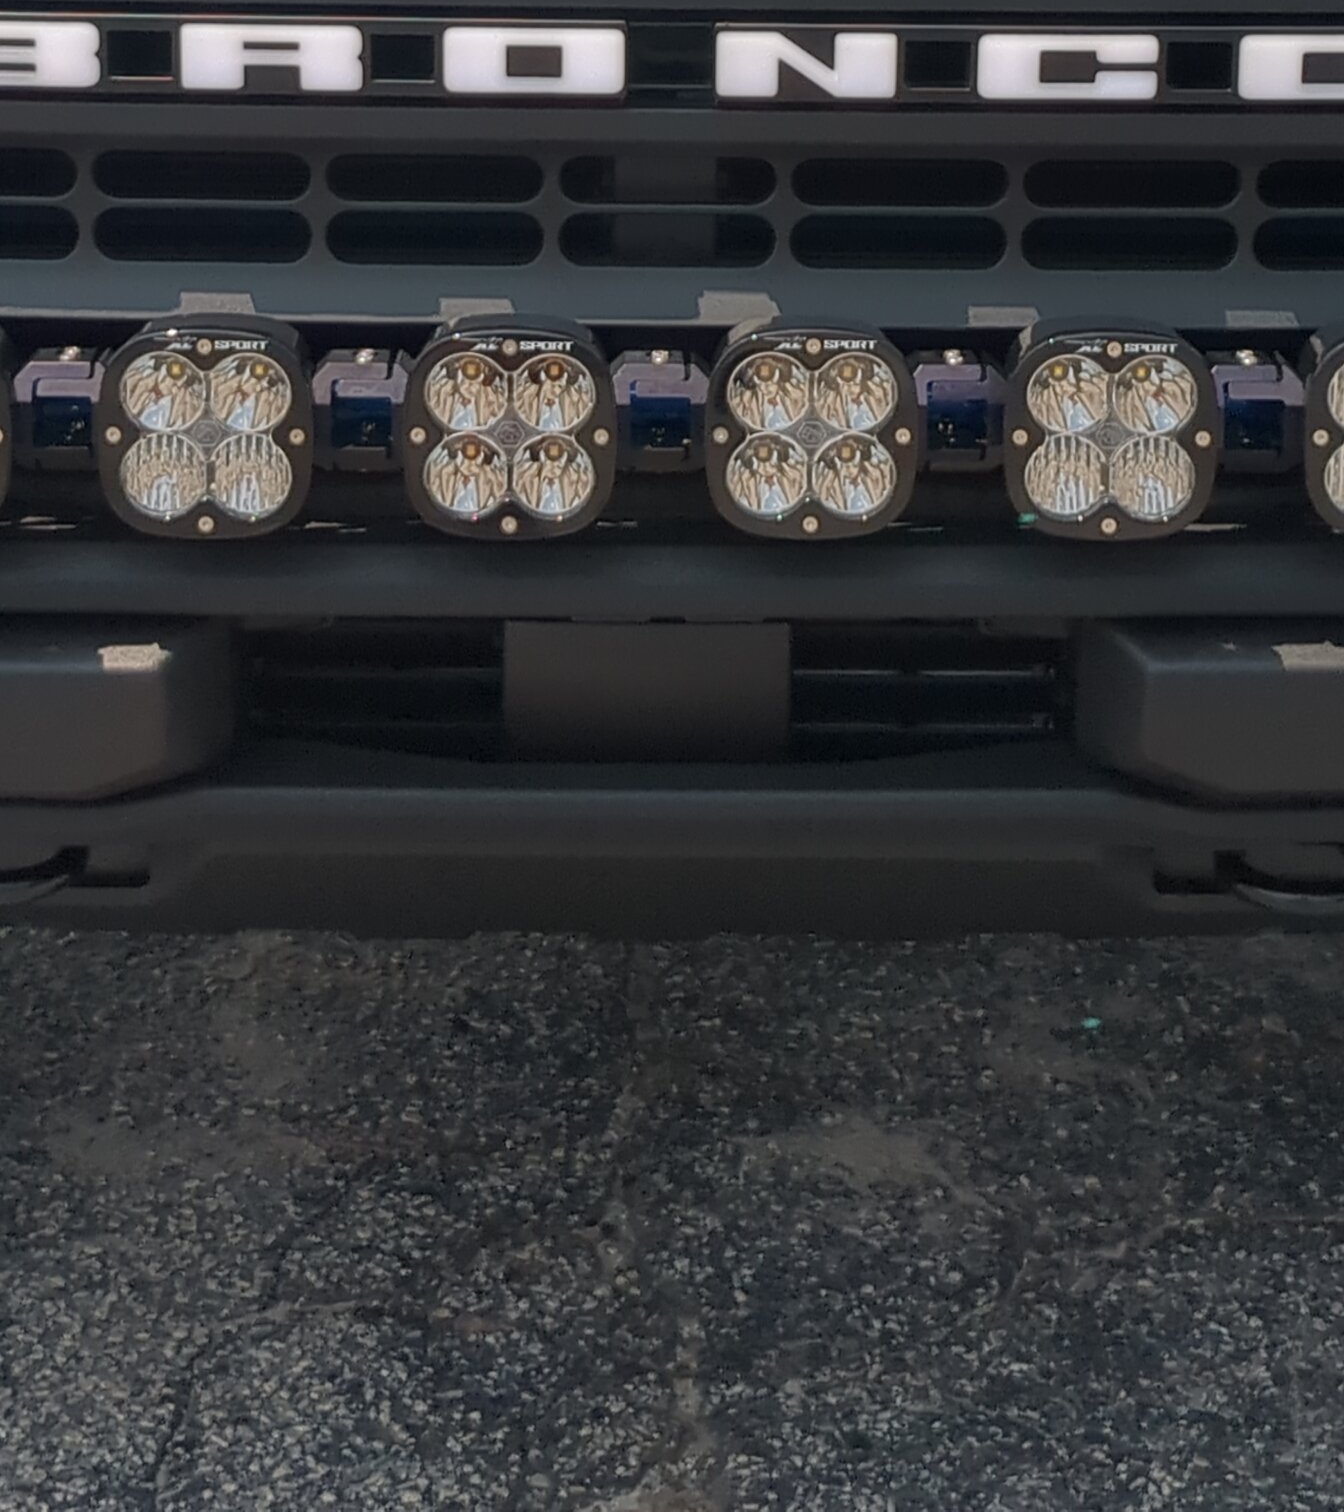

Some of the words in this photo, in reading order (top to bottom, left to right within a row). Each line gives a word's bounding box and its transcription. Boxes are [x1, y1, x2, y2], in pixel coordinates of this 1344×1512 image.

[214, 339, 269, 351] SPORT
[519, 340, 574, 351] SPORT
[823, 339, 878, 350] SPORT
[1124, 343, 1178, 353] SPORT
